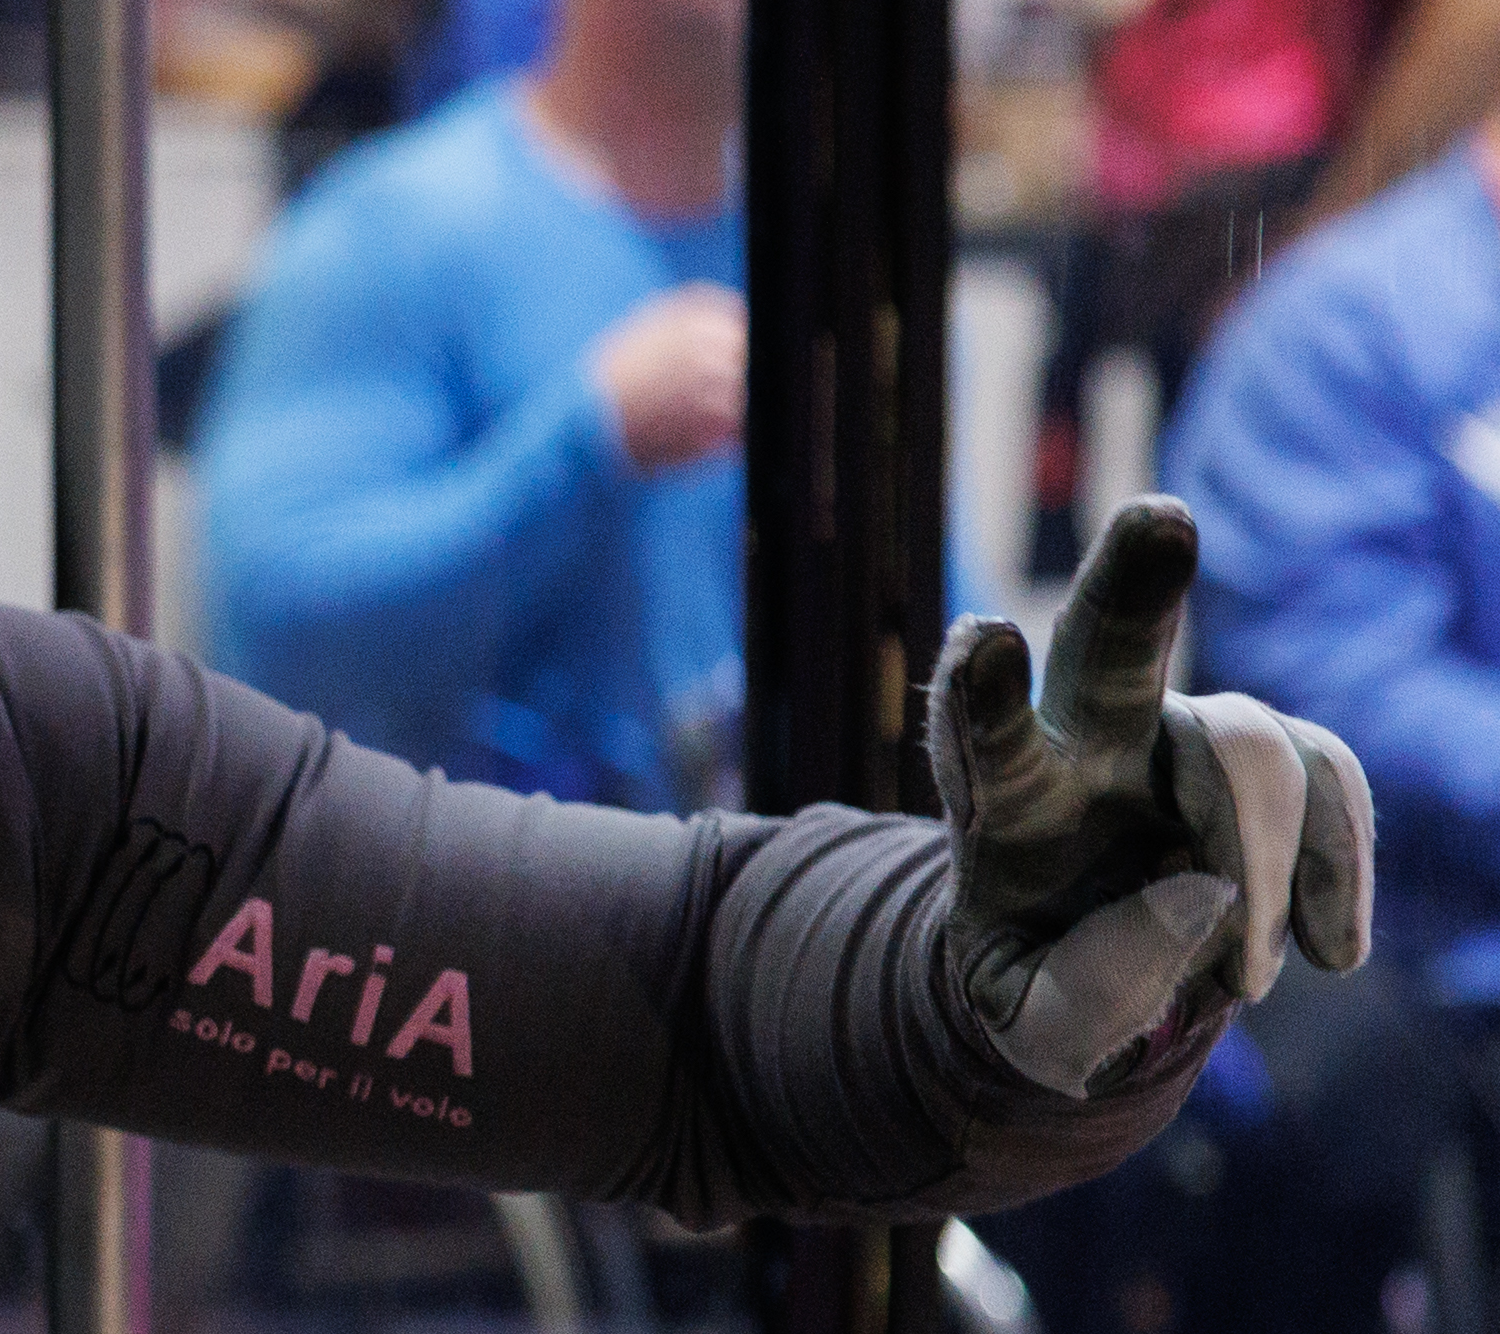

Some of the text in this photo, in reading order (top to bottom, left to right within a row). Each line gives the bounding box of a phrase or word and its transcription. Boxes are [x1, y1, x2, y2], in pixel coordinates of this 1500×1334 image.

[186, 896, 475, 1079] AriA
[168, 1008, 257, 1055] solo
[264, 1047, 339, 1090] per
[389, 1082, 473, 1128] volo
